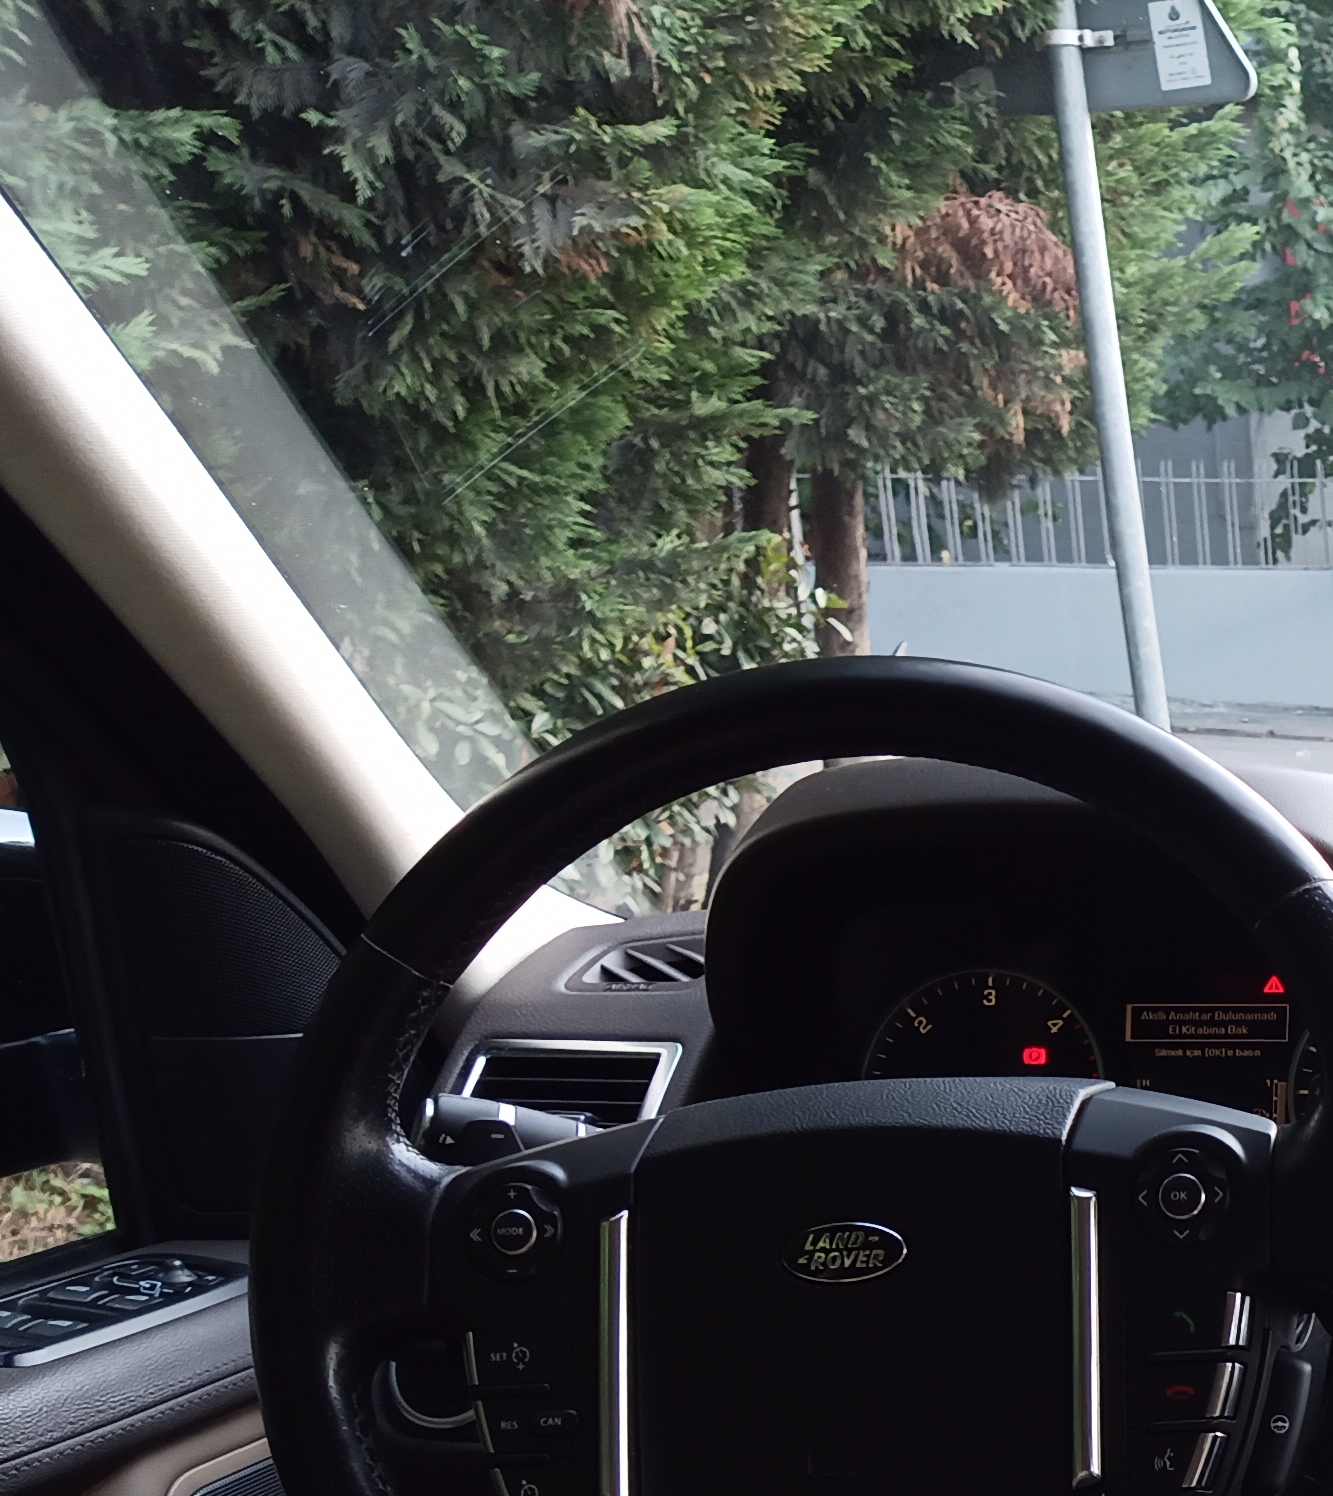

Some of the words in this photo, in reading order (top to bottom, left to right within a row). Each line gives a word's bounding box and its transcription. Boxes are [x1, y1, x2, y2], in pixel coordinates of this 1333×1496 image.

[982, 989, 996, 1006] 3
[1169, 1011, 1212, 1020] Anahtar
[913, 1016, 932, 1034] 2
[1047, 1019, 1064, 1034] 4
[1170, 1190, 1188, 1200] OK
[496, 1227, 524, 1236] MODE
[490, 1352, 507, 1362] SET
[500, 1420, 518, 1429] RES
[540, 1417, 562, 1426] CAN
